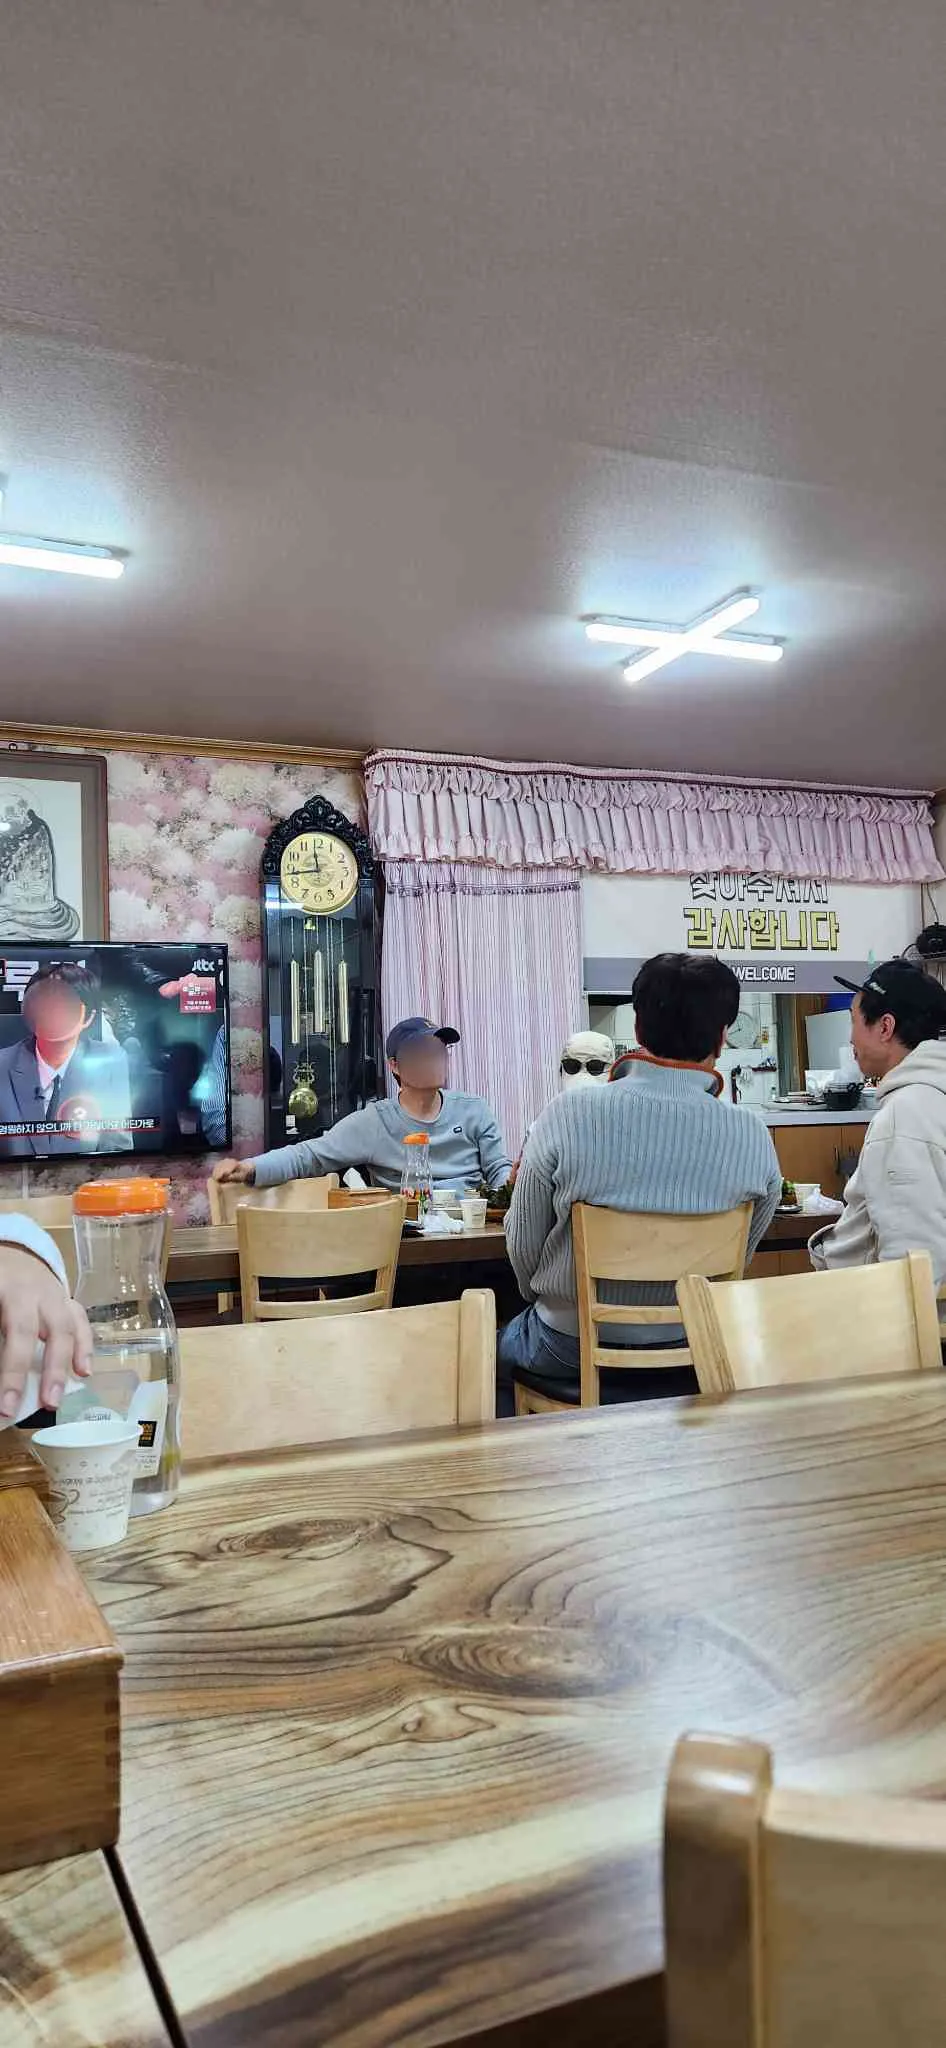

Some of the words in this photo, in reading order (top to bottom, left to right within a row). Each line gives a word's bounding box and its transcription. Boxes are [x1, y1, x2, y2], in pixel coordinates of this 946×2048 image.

[300, 841, 308, 851] 11
[291, 876, 299, 889] 8
[314, 891, 322, 903] 6
[683, 907, 840, 951] 감사합니다
[732, 966, 795, 982] WELCOME
